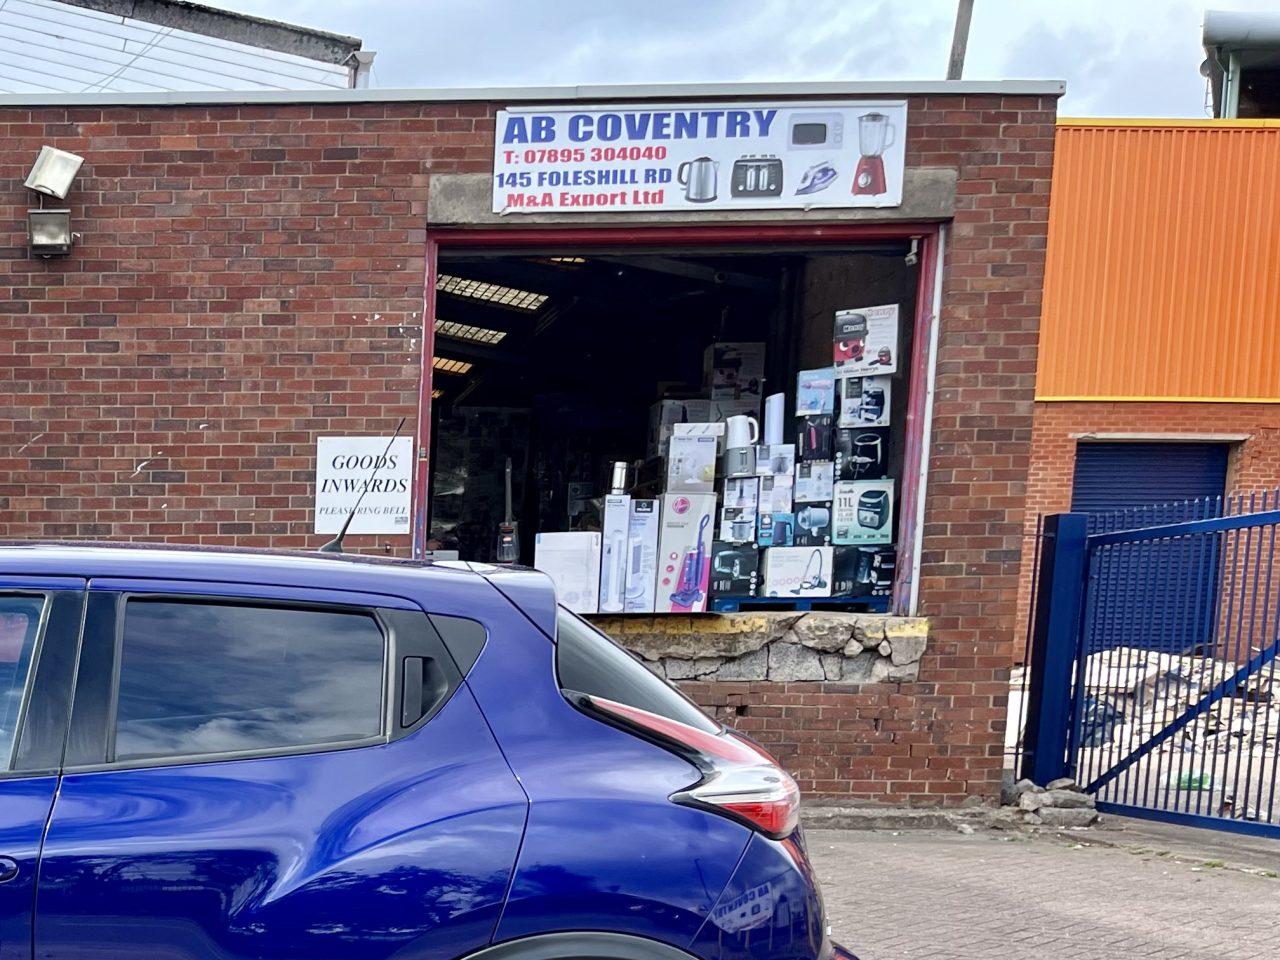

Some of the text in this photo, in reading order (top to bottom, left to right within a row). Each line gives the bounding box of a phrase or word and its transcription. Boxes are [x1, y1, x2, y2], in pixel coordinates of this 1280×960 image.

[502, 110, 778, 144] AB COVENTRY
[504, 146, 667, 164] T: 07895 304040
[496, 168, 672, 188] 145 FOLESHILL RD
[506, 189, 664, 208] M&A Export Ltd
[321, 455, 408, 493] GOODS INWARDS
[357, 506, 381, 515] RING
[383, 506, 408, 515] BELL
